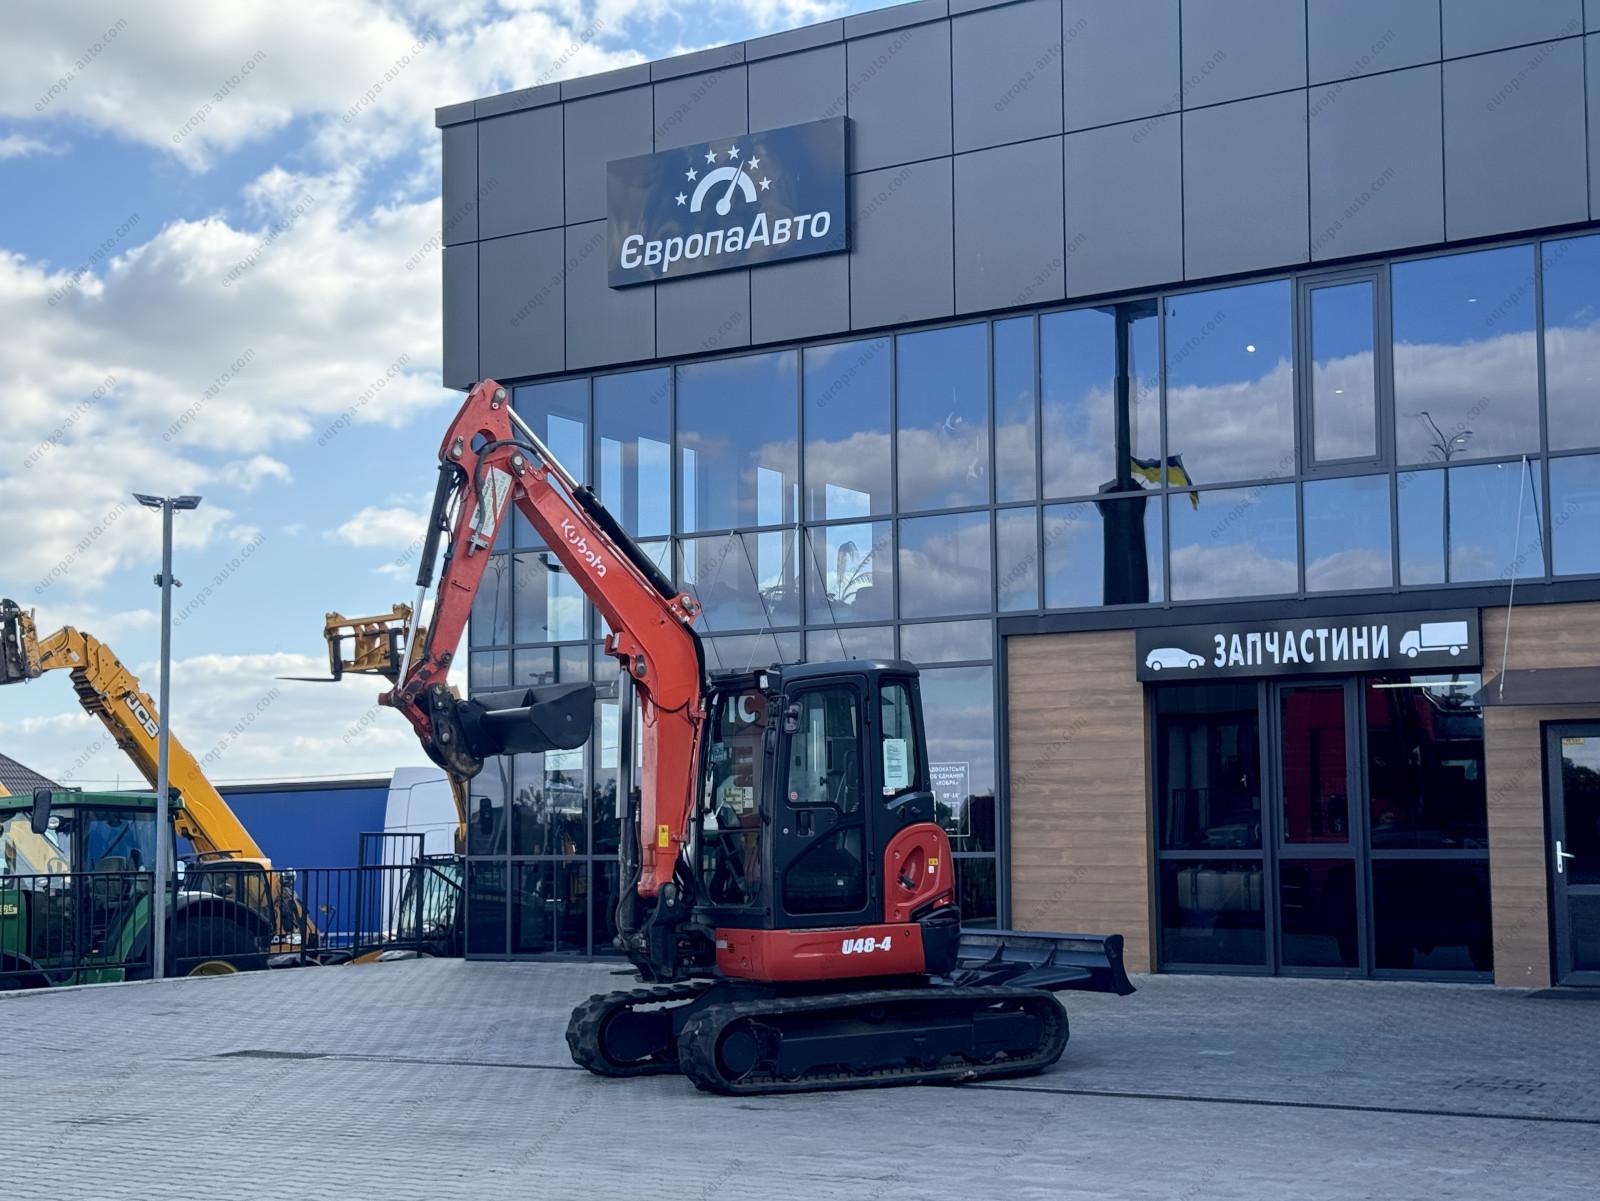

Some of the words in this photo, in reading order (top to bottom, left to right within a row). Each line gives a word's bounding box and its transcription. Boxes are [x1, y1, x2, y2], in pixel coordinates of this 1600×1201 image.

[620, 211, 831, 273] ЄвропаАвто
[561, 518, 607, 578] Kubota
[1213, 625, 1389, 668] ЗАПЧАСТИНИ
[126, 692, 160, 738] JCB
[842, 936, 892, 954] U48-4
